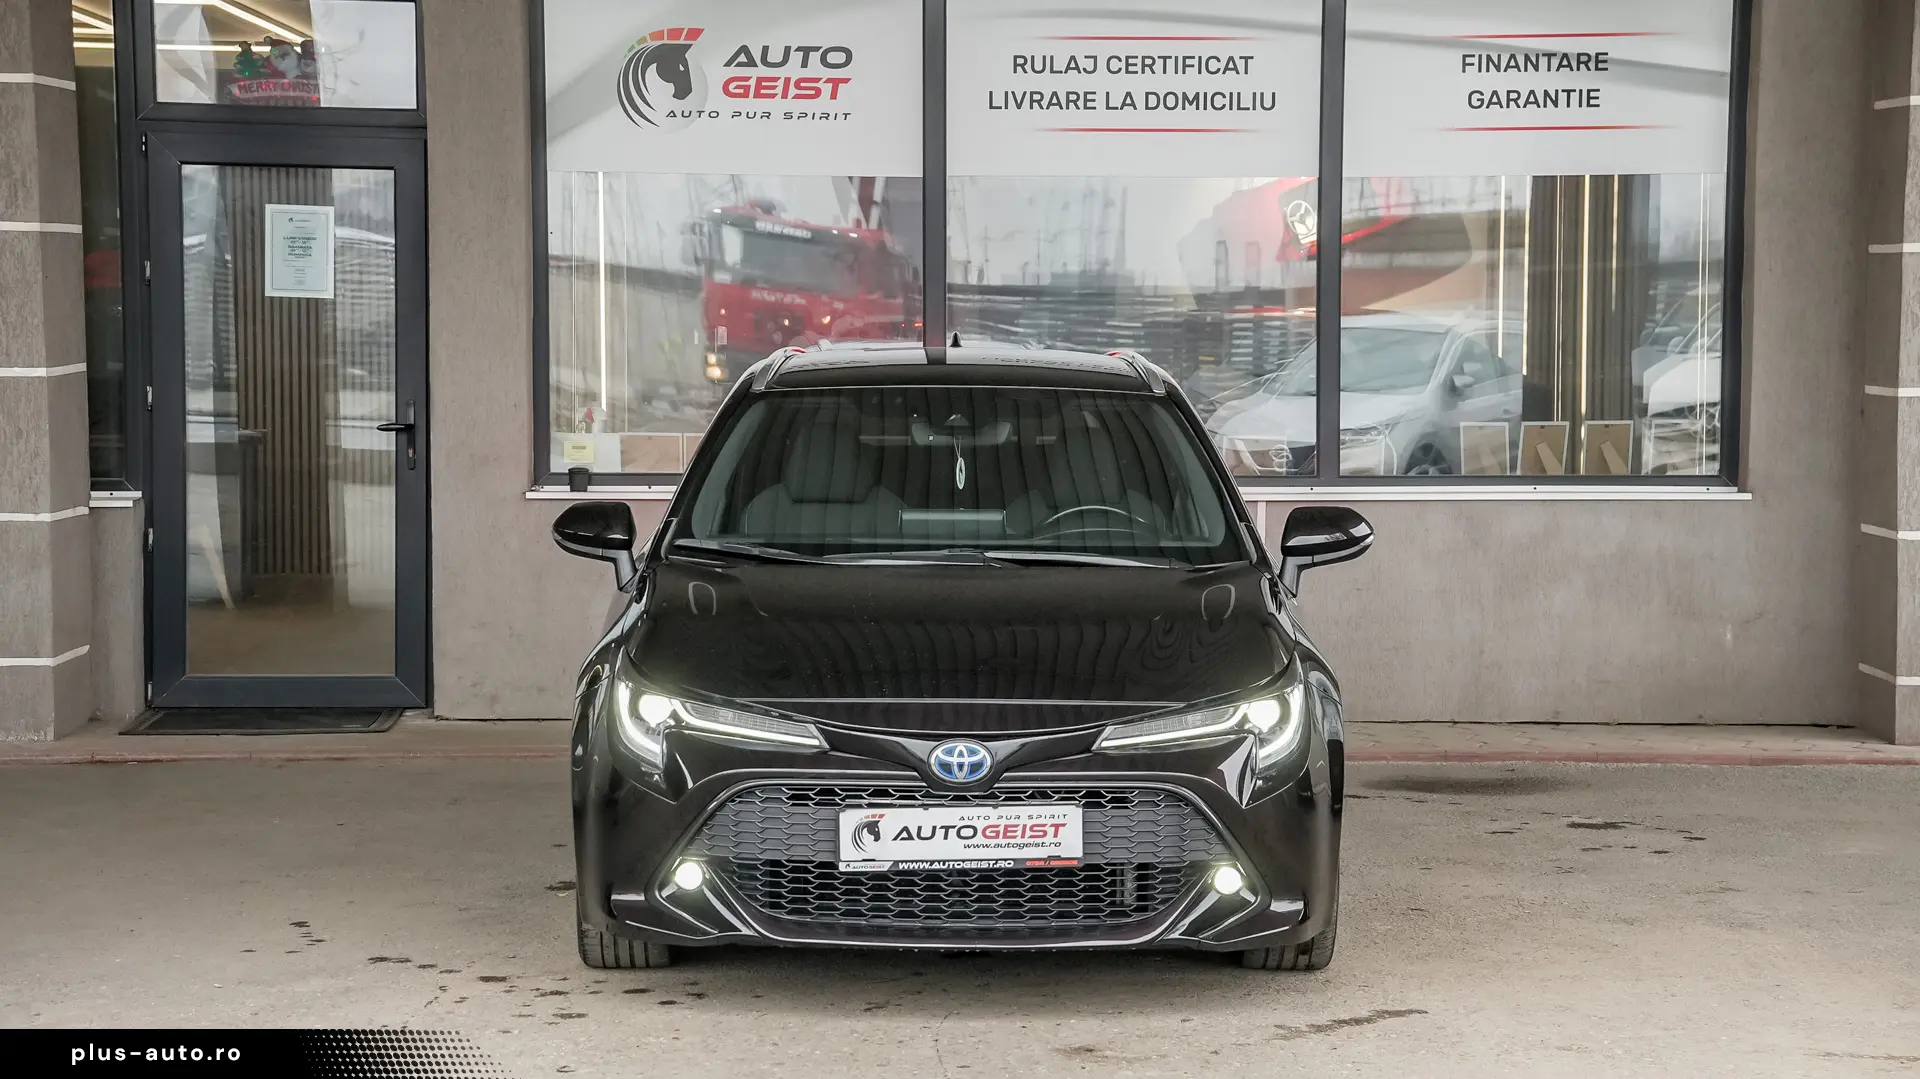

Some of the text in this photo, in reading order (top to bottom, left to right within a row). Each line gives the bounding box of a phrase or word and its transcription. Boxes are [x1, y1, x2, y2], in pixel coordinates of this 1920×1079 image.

[723, 44, 853, 69] AUTO
[1013, 55, 1254, 75] RULAJ CERTIFICAT
[1461, 52, 1609, 73] FINANTARE
[238, 81, 277, 94] MERRY
[722, 76, 852, 100] GEIST
[988, 91, 1276, 111] LIVRARE LA DOMICILIU
[1467, 88, 1601, 109] GARANTIE
[666, 110, 852, 121] AUTO PUR SPIRIT
[963, 840, 1062, 851] www.autogeist.ro
[898, 860, 1015, 870] WWW.AUTOGEIST.RO
